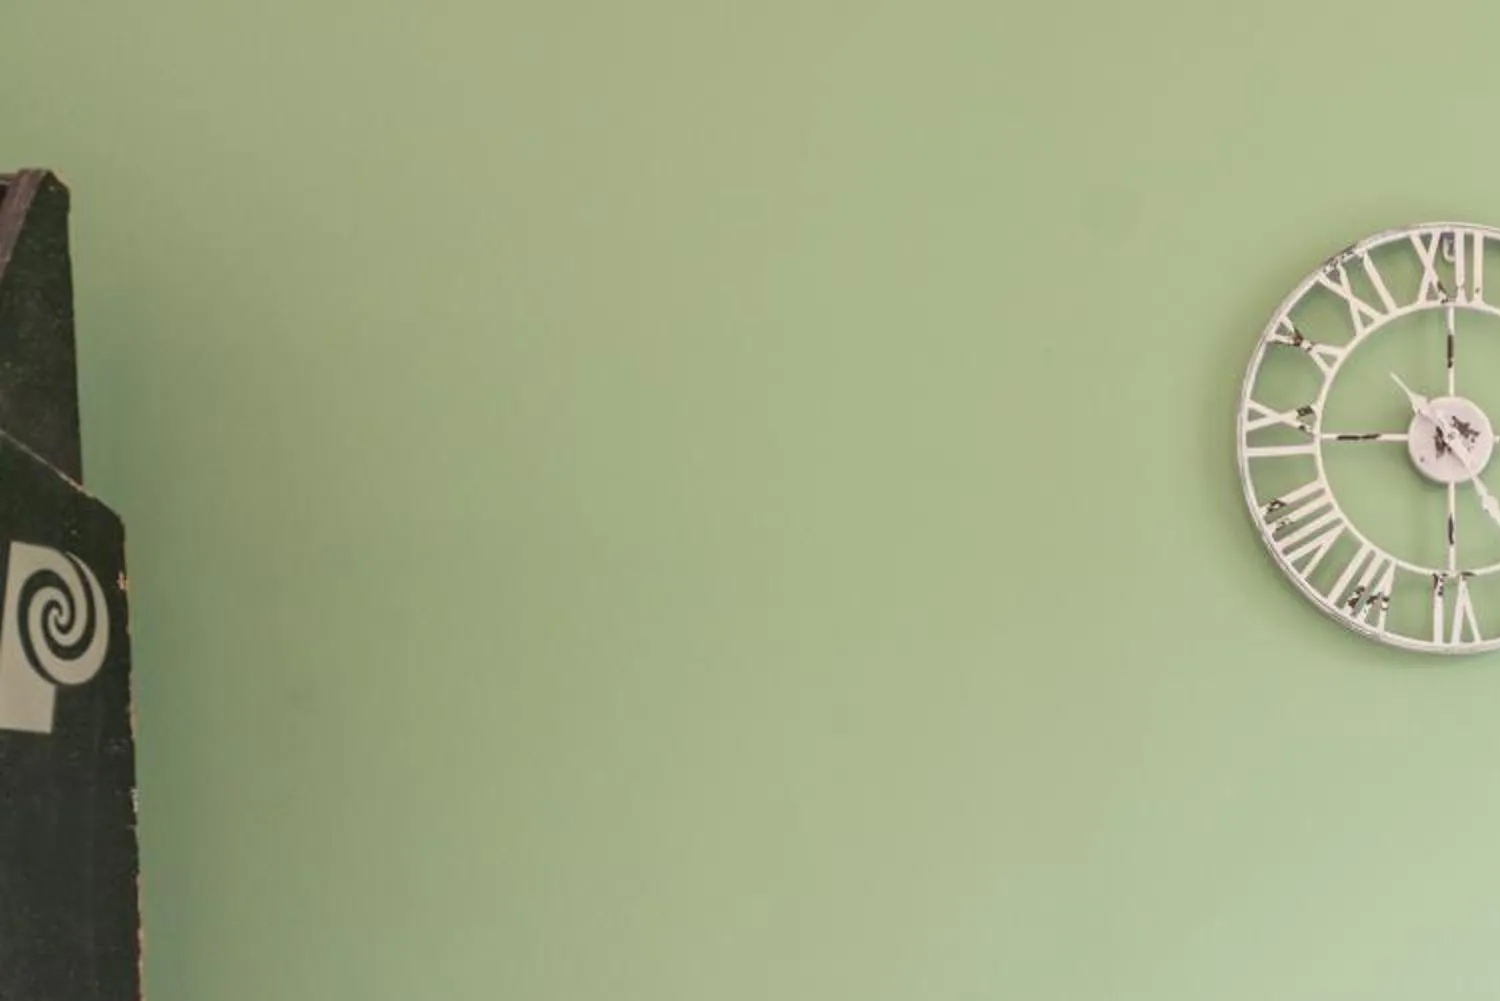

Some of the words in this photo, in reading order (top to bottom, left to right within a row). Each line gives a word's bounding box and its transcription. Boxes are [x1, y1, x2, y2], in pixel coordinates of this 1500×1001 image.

[1318, 250, 1398, 336] XI
[1410, 231, 1484, 304] XII
[1245, 399, 1319, 457] IX
[1258, 475, 1348, 580] VIII
[1328, 542, 1396, 634] VII
[1431, 572, 1482, 646] VI
